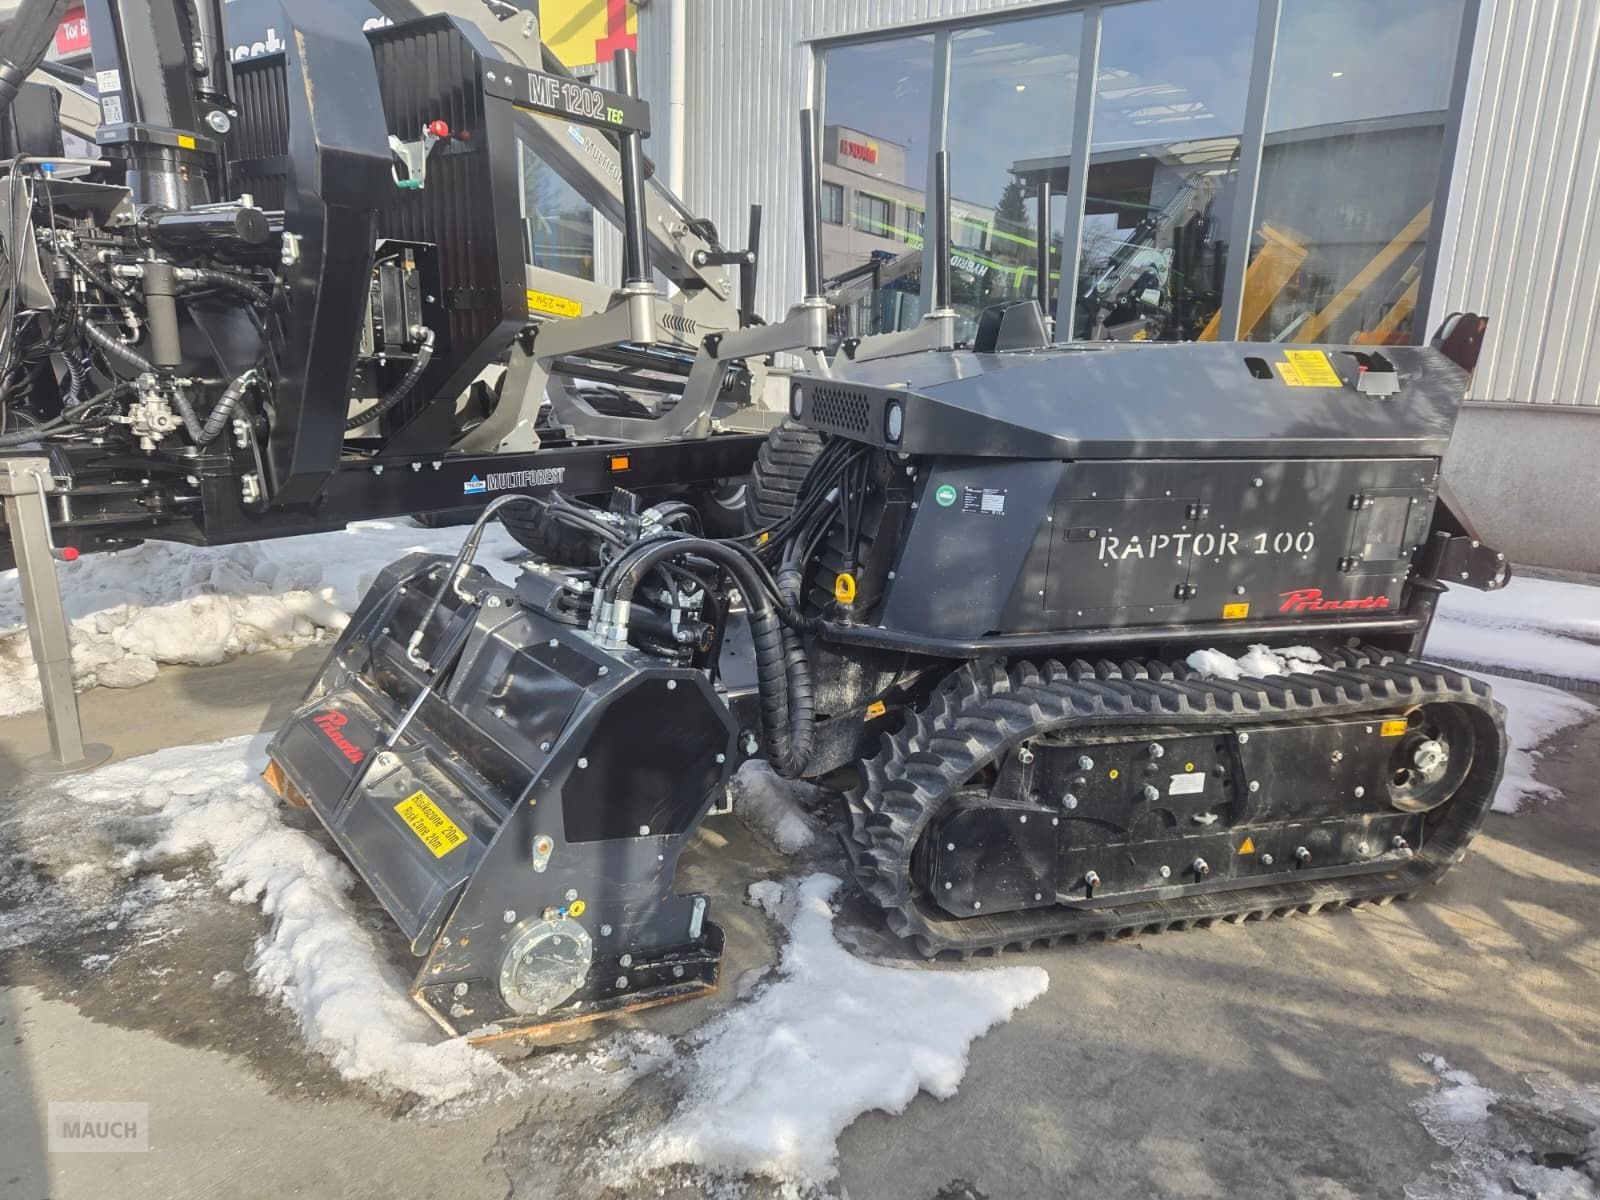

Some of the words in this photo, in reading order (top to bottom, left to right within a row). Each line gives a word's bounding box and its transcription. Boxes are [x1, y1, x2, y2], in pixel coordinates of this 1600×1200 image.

[63, 23, 79, 41] Tor
[527, 72, 560, 109] MF
[561, 83, 606, 121] 1202
[606, 106, 624, 125] TEC
[950, 255, 989, 277] HYBRID
[486, 467, 566, 491] MULTIFOREST
[1098, 532, 1240, 560] RAPTOR
[1253, 531, 1316, 554] 100
[1279, 588, 1390, 612] Prinoth
[402, 806, 419, 822] Risk
[412, 817, 431, 836] Zone
[425, 832, 442, 850] 20m
[410, 793, 445, 828] Risikozone
[441, 825, 460, 845] 20m
